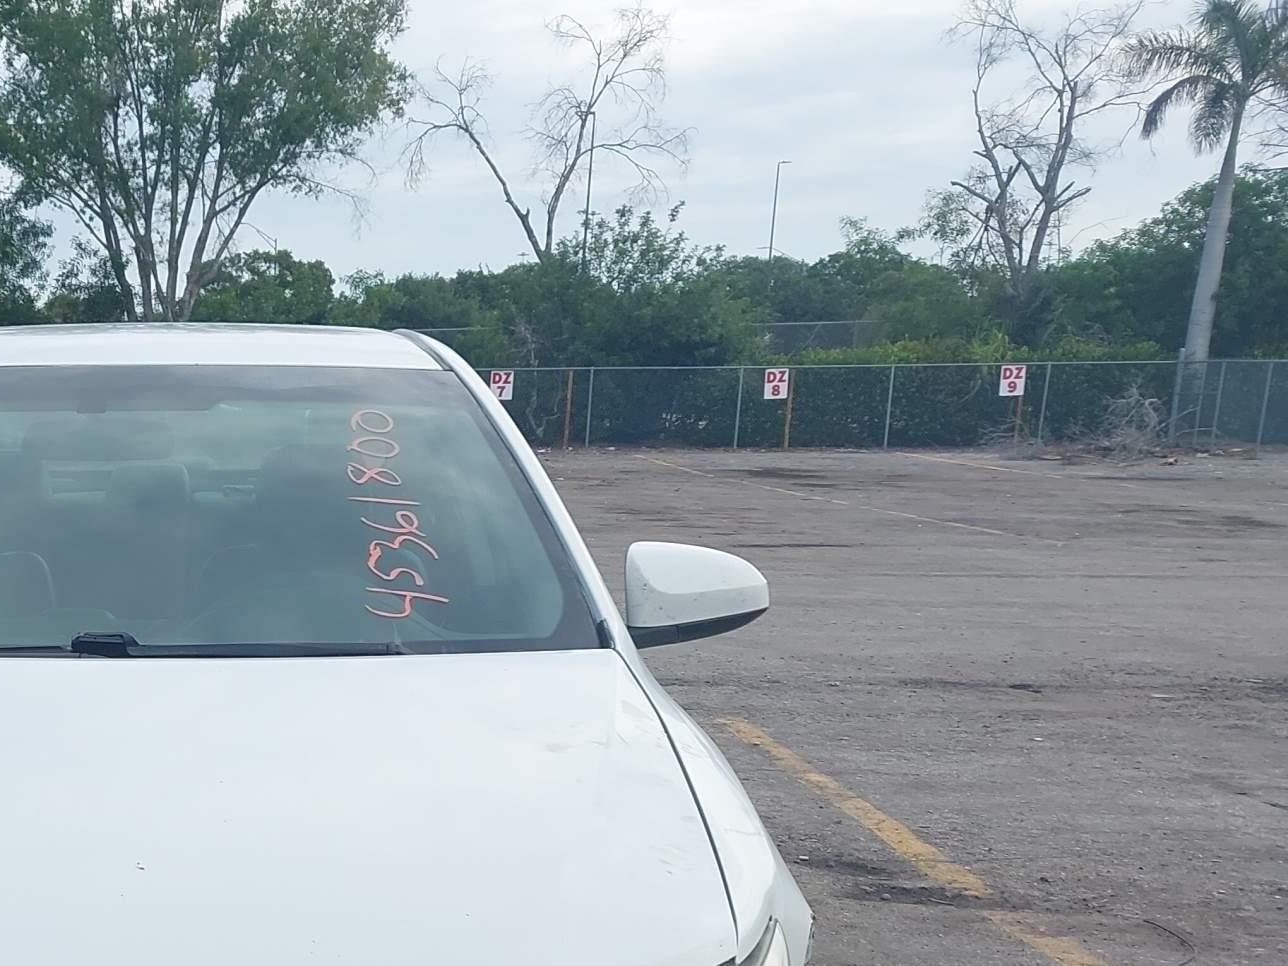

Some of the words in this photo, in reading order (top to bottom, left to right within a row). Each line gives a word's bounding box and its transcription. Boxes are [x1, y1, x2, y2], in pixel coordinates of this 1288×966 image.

[492, 372, 512, 384] DZ
[767, 370, 787, 384] DZ
[1003, 366, 1025, 380] DZ
[496, 385, 507, 398] 7
[771, 384, 781, 397] 8
[1007, 380, 1018, 393] 9
[345, 409, 450, 618] 45361800
